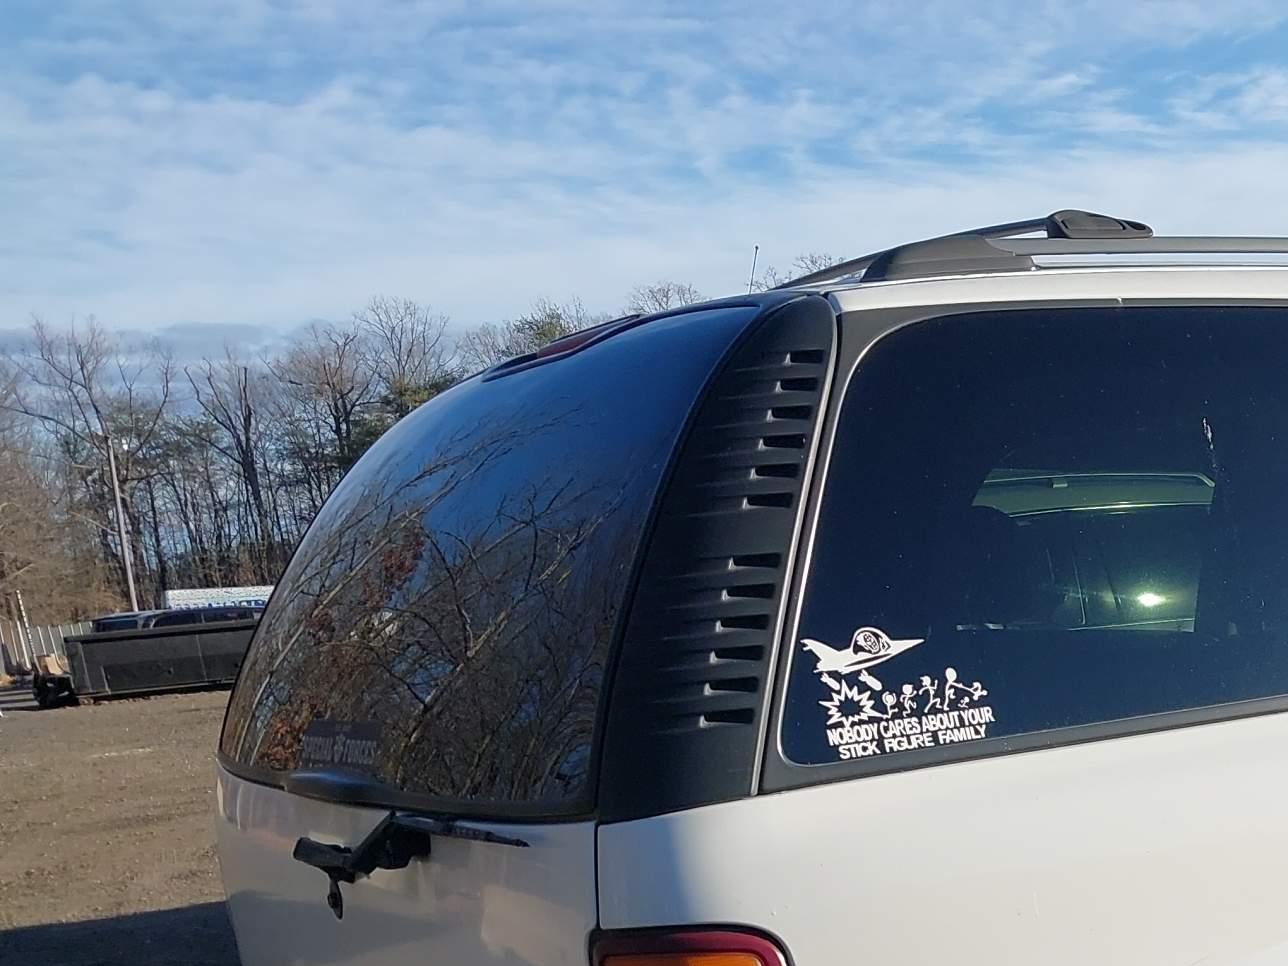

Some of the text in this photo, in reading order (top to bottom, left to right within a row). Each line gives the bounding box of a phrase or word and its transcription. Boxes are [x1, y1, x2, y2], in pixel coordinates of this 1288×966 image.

[826, 706, 995, 747] NOBODY CARES ABOUT YOUR
[838, 725, 987, 760] STICK FIGURE FAMILY
